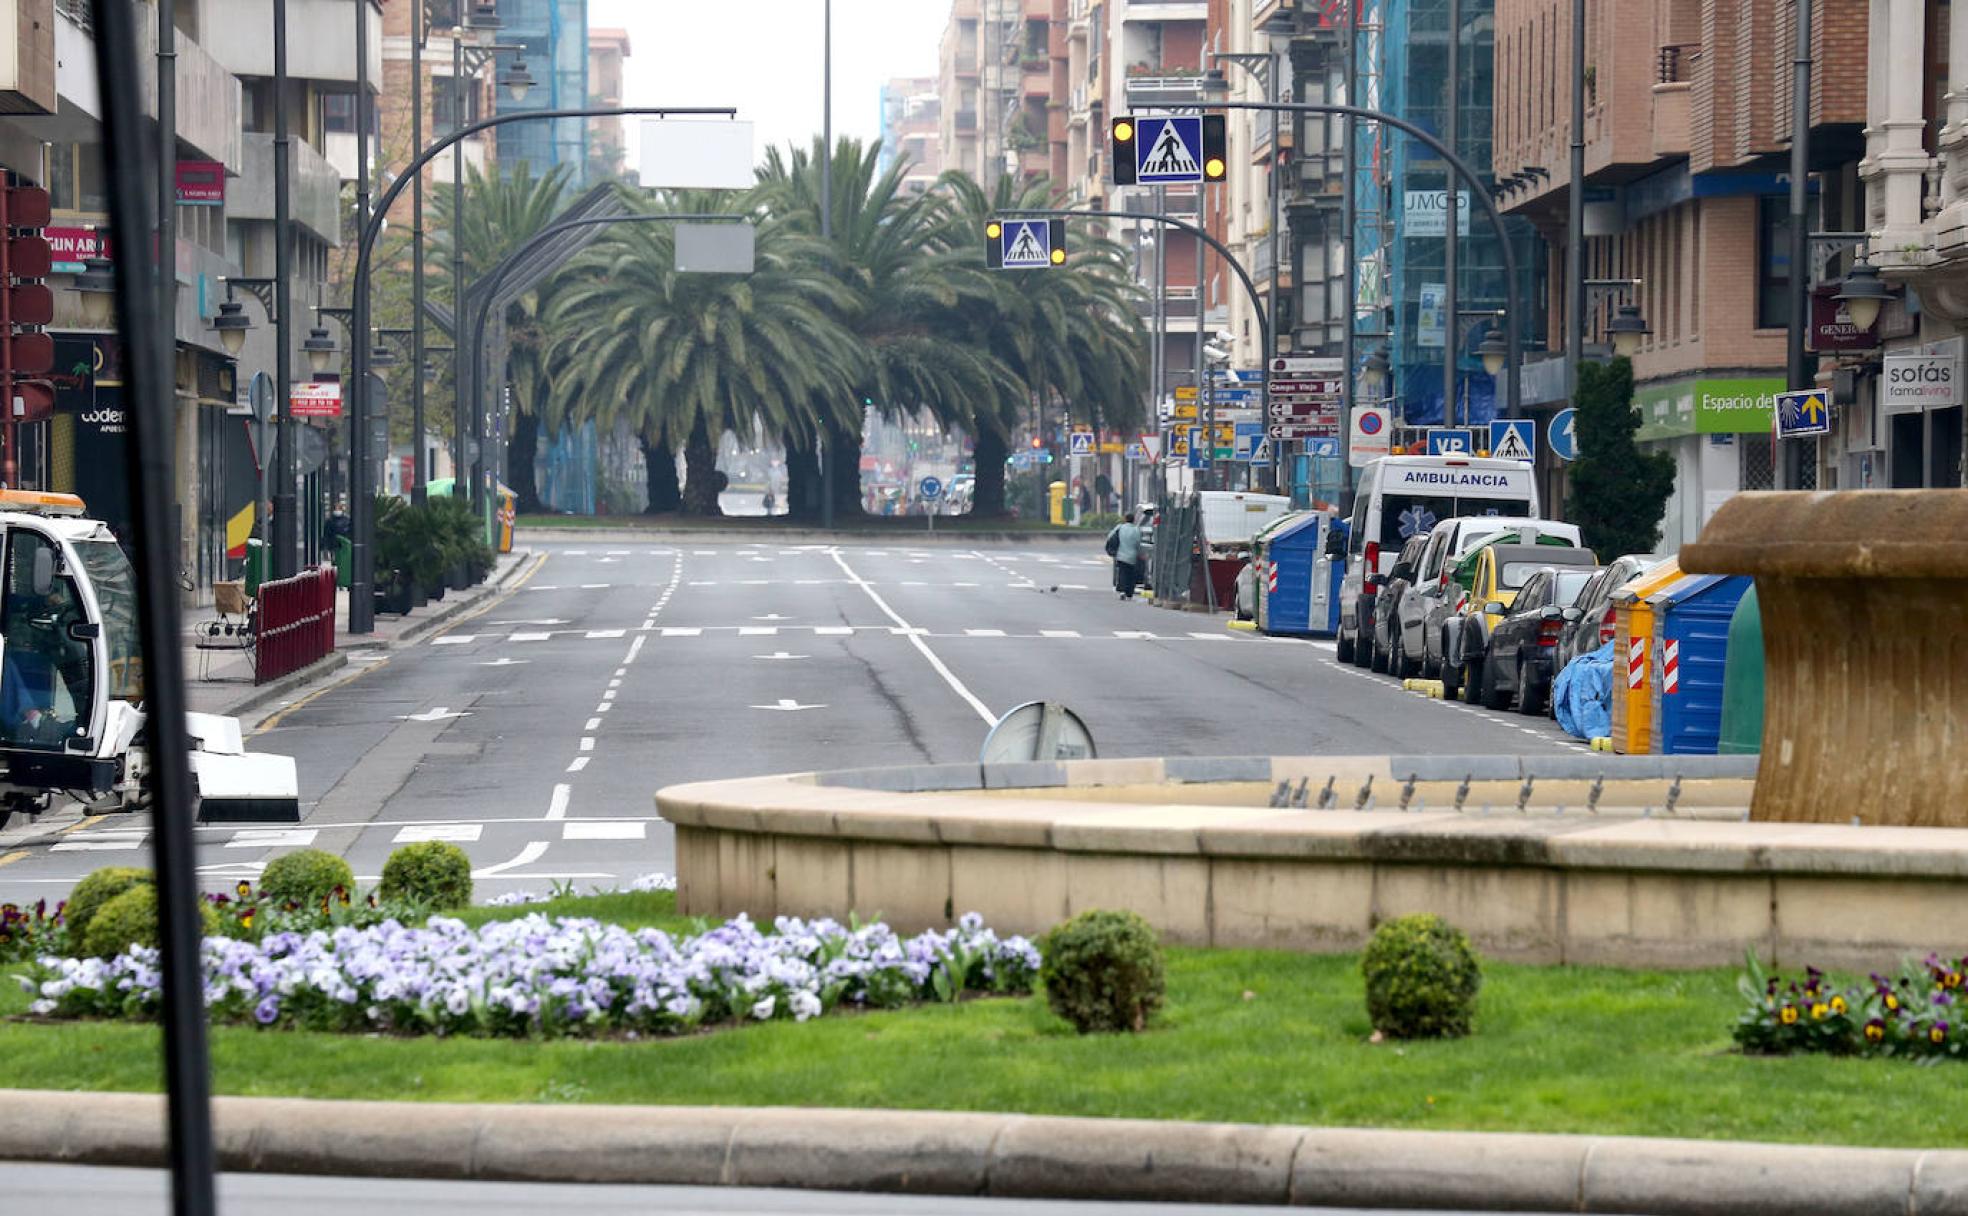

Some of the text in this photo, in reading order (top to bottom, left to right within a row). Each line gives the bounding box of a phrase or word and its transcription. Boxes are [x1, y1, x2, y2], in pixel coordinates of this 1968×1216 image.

[1890, 361, 1951, 383] sofás
[1890, 385, 1952, 398] famaliving
[1702, 393, 1753, 413] Espacio
[1436, 438, 1465, 452] VP
[1404, 471, 1509, 487] AMBULANCIA
